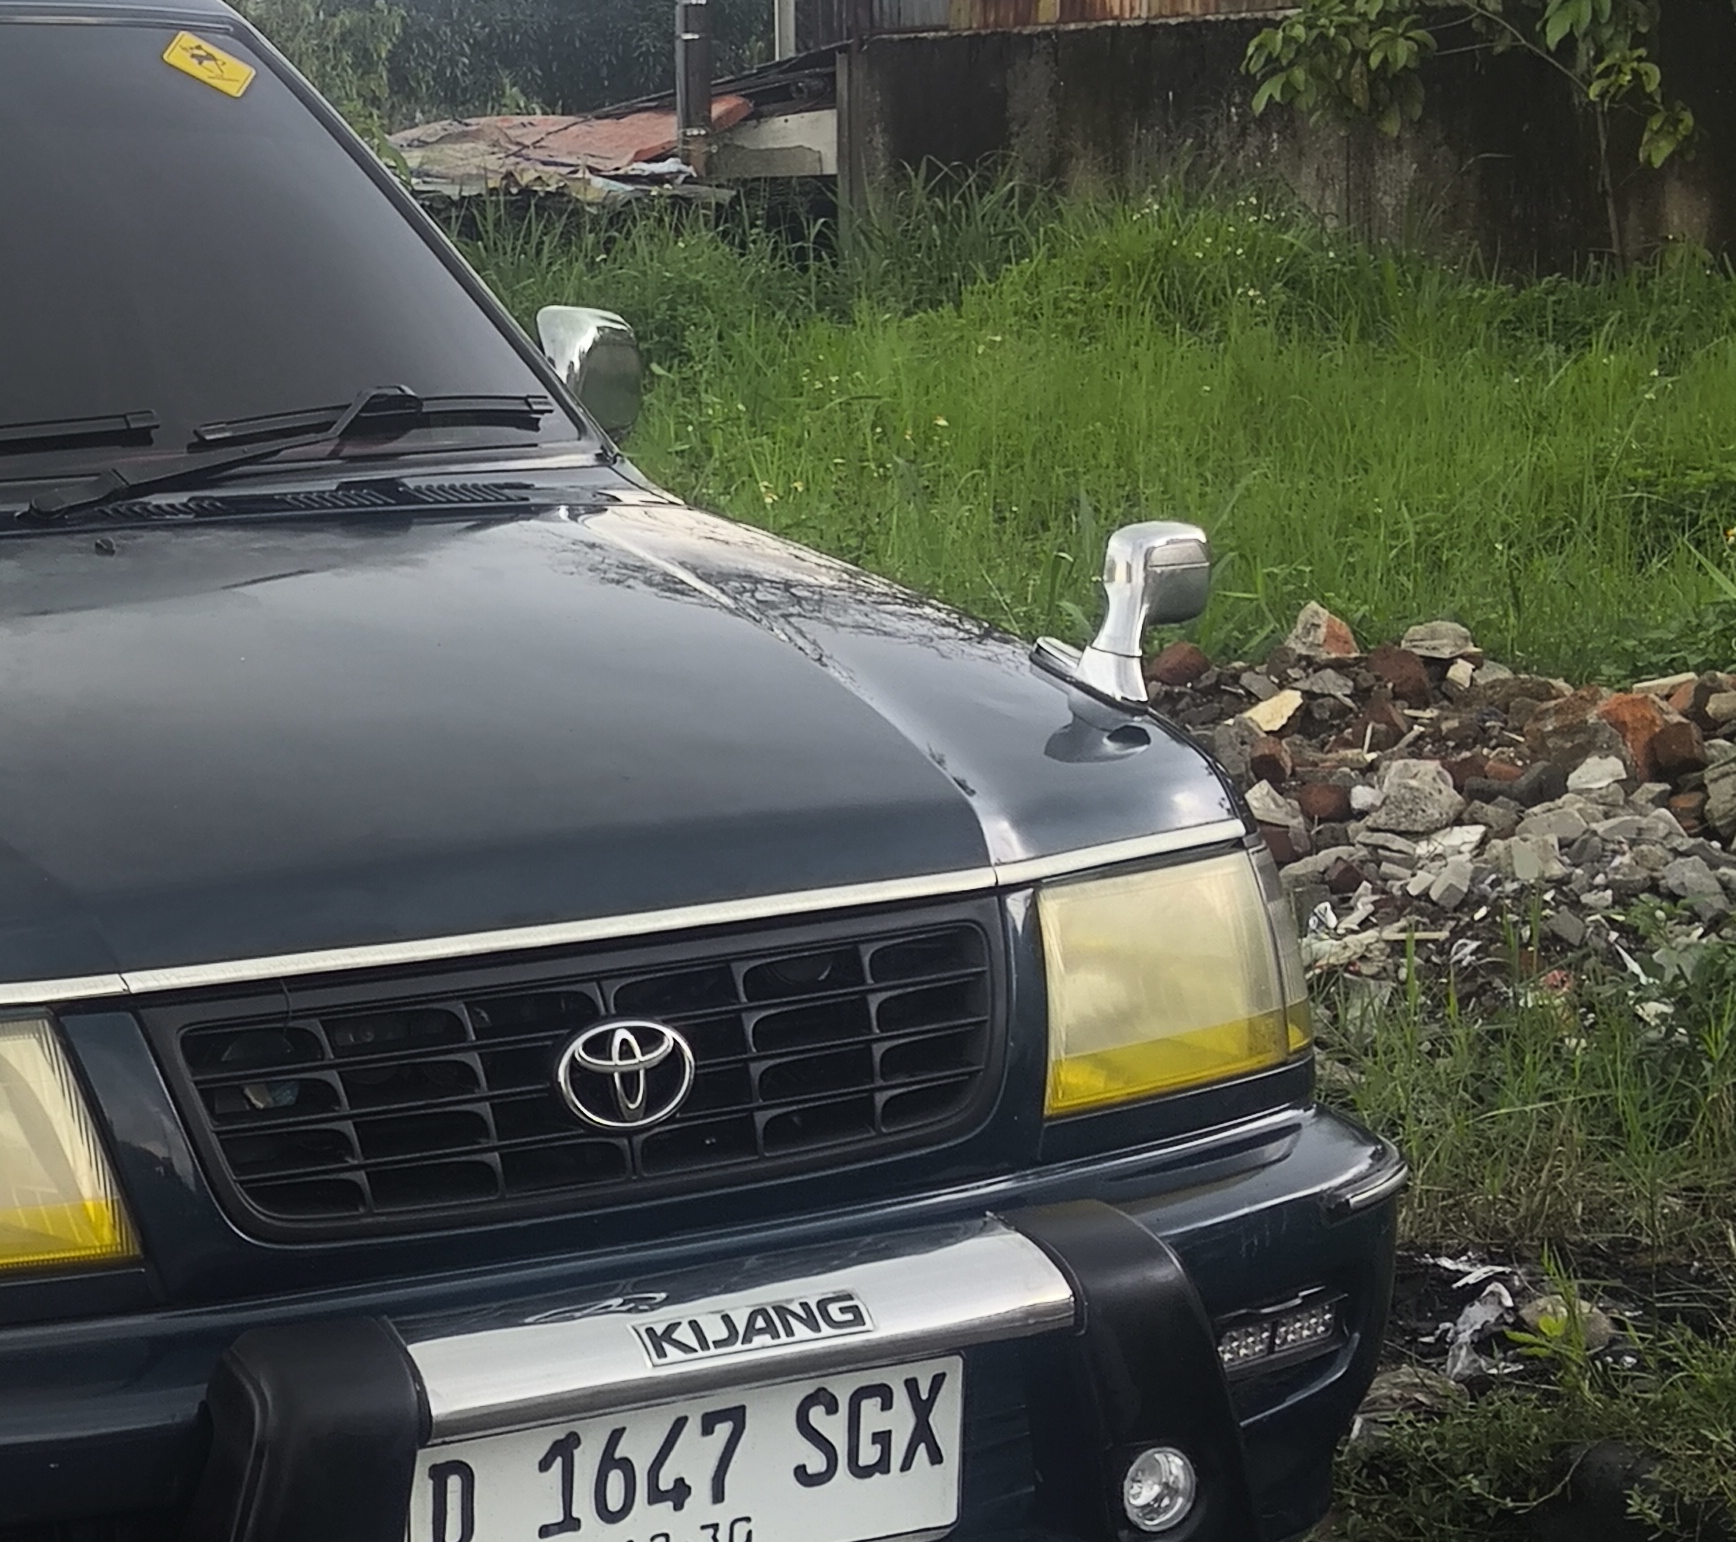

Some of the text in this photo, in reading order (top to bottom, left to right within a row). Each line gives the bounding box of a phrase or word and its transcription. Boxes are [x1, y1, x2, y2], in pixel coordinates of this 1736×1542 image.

[645, 1294, 867, 1359] KIJANG
[537, 1404, 748, 1539] 1647
[793, 1371, 948, 1489] SGX
